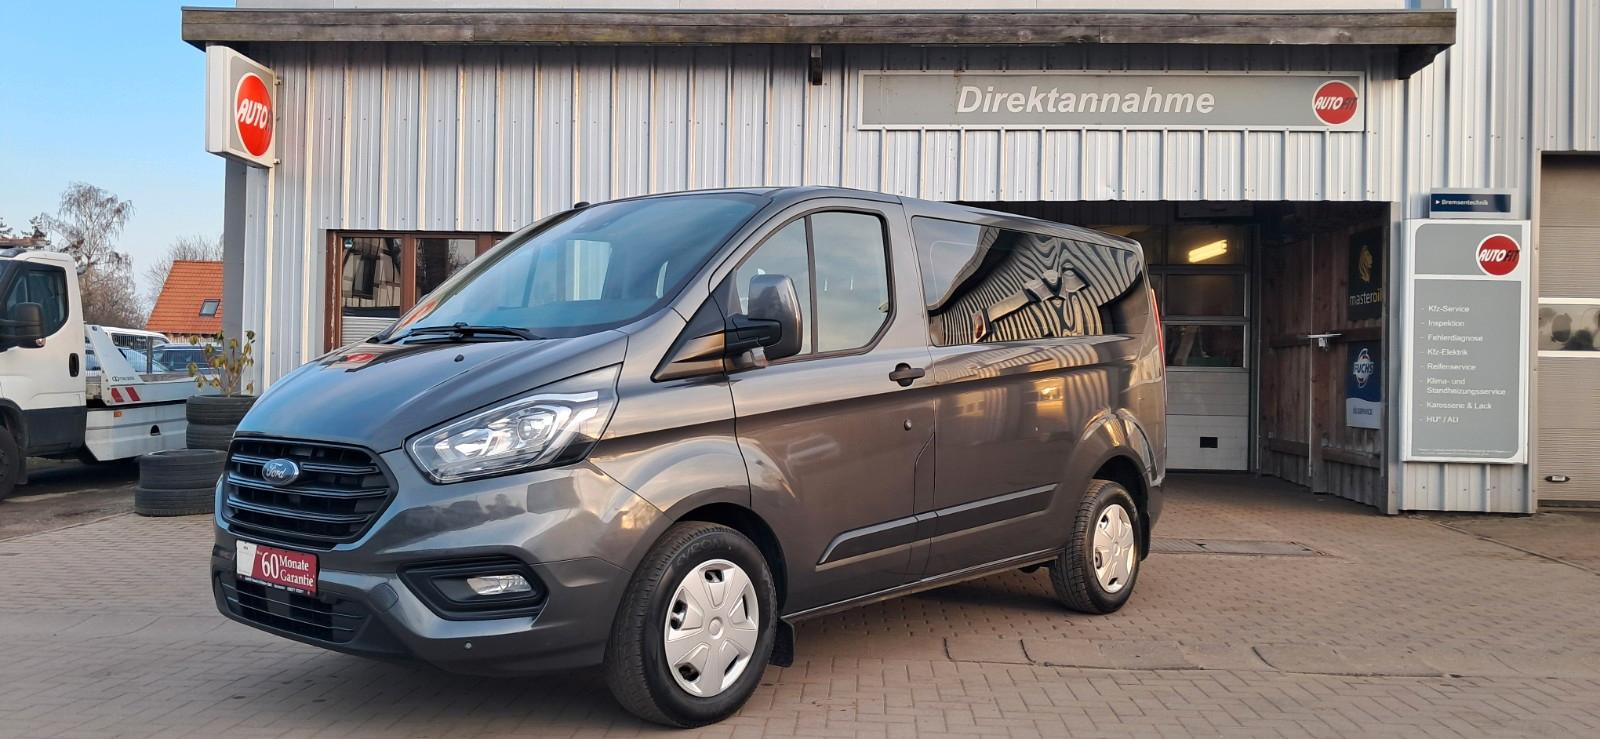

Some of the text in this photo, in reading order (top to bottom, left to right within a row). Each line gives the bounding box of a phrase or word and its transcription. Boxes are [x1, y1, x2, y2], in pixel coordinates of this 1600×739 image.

[957, 86, 1216, 114] Direktannahme
[1428, 304, 1470, 313] Kfz-Service
[1428, 319, 1465, 328] Inspektion
[1427, 334, 1484, 343] Fehlerdiagnose
[1427, 348, 1468, 356] Kfz-Elektrik
[1353, 362, 1375, 374] FUCHS
[1426, 362, 1477, 371] Reifenservice
[1426, 377, 1466, 386] Klima- und
[1426, 387, 1507, 396] Standheizungsservice
[1426, 401, 1465, 410] Karosserie
[1474, 402, 1492, 410] Lack
[1447, 416, 1459, 424] AU
[266, 461, 287, 479] Ford
[261, 552, 309, 579] 60 Monate
